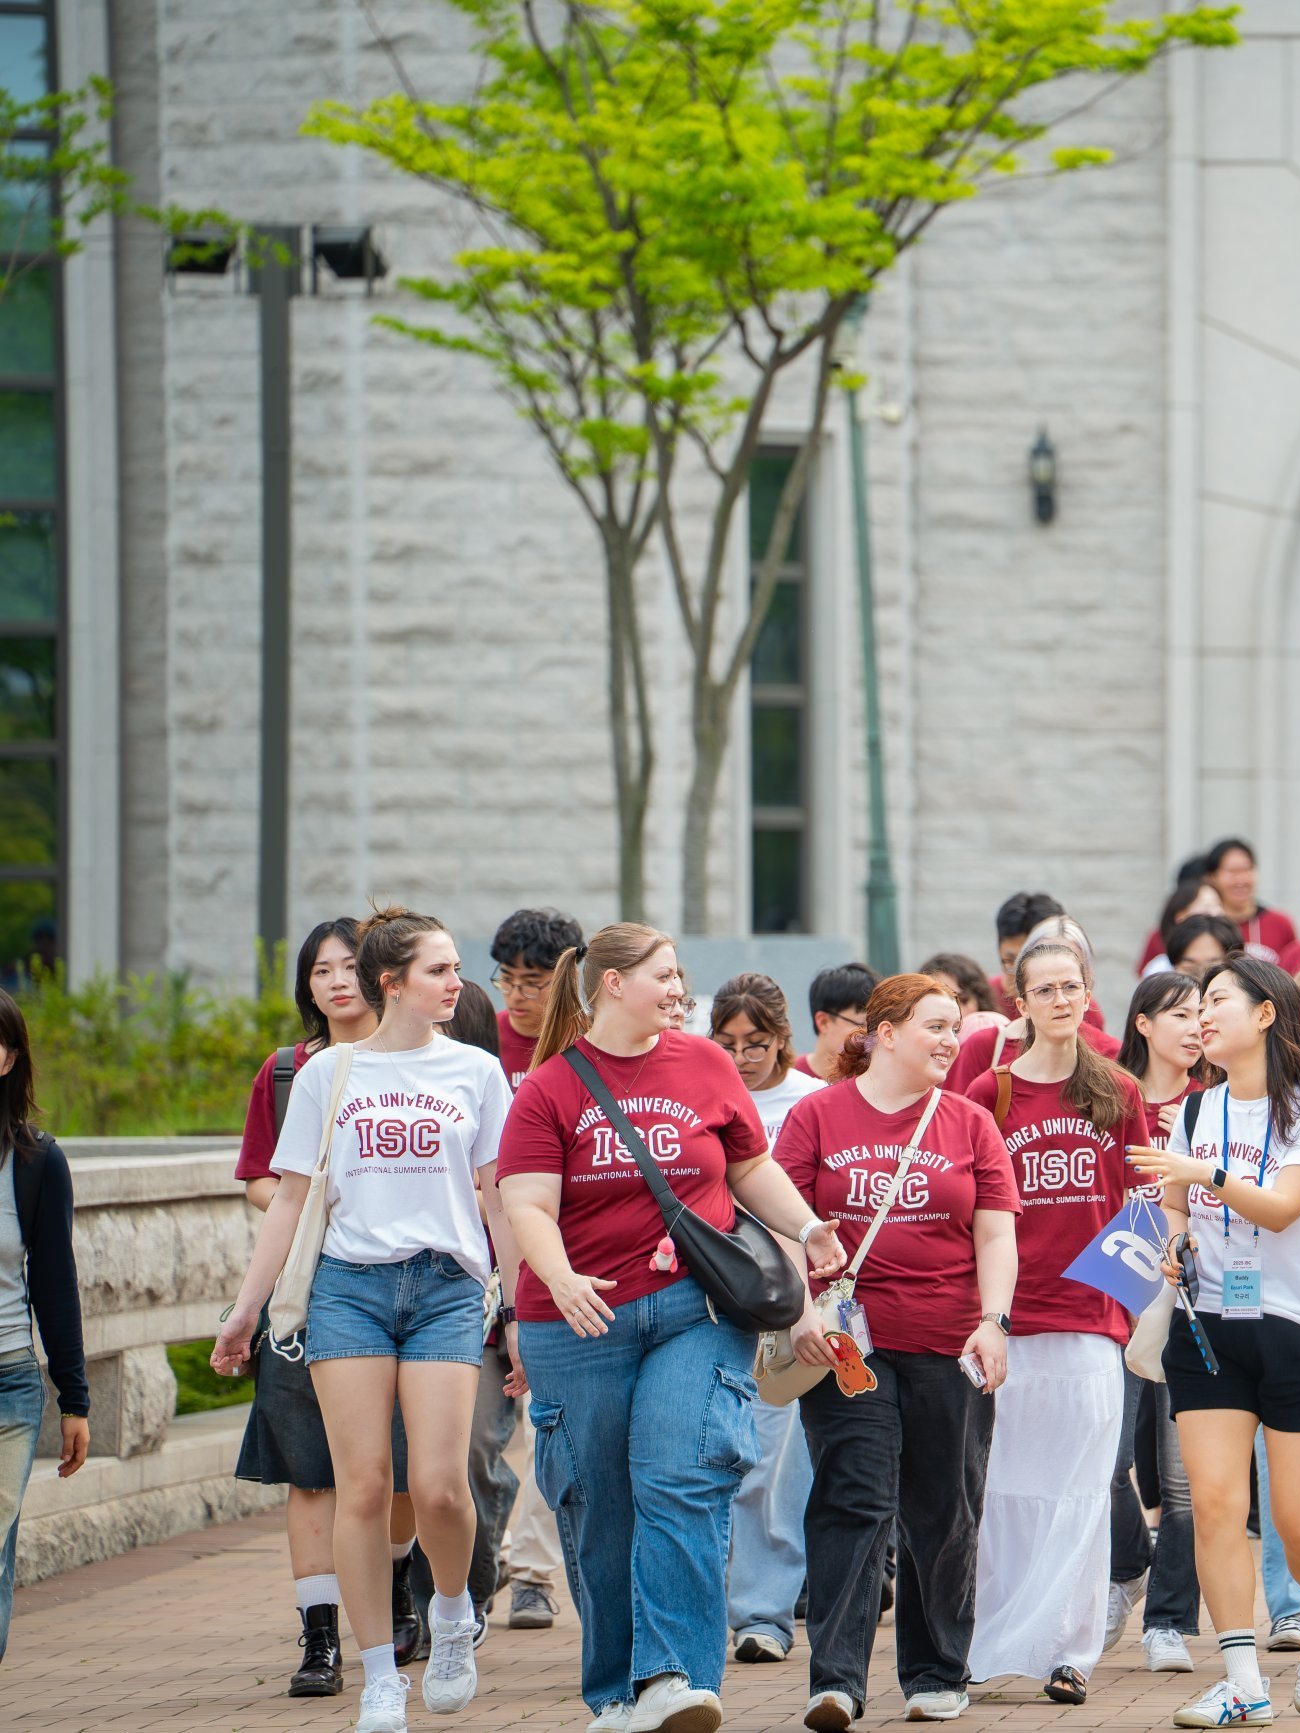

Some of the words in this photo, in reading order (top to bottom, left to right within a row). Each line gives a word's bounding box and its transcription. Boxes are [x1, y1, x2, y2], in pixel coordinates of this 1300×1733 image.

[335, 1096, 376, 1129] KOREA
[379, 1092, 465, 1124] UNIVERSITY
[575, 1105, 607, 1135] ORE
[617, 1097, 702, 1128] UNIVERSITY
[355, 1118, 441, 1158] ISC
[591, 1123, 682, 1167] ISC
[1005, 1124, 1042, 1156] OREA
[1042, 1117, 1117, 1152] UNIVERSTY
[1191, 1143, 1218, 1161] REA
[393, 1166, 427, 1174] SUMMER
[571, 1170, 632, 1183] INTERNATIONAL
[633, 1169, 669, 1177] SUER
[670, 1167, 701, 1176] CAMPUS
[824, 1146, 871, 1171] KOREA
[875, 1144, 955, 1173] UNIRSITY
[1022, 1147, 1097, 1192] ISC
[846, 1168, 930, 1210] ISC
[1020, 1197, 1054, 1207] RNATIONAL
[1055, 1195, 1086, 1204] SUMMER
[828, 1210, 874, 1224] INTERNATION
[884, 1214, 917, 1224] SUMMER
[918, 1212, 951, 1221] CAMPUS
